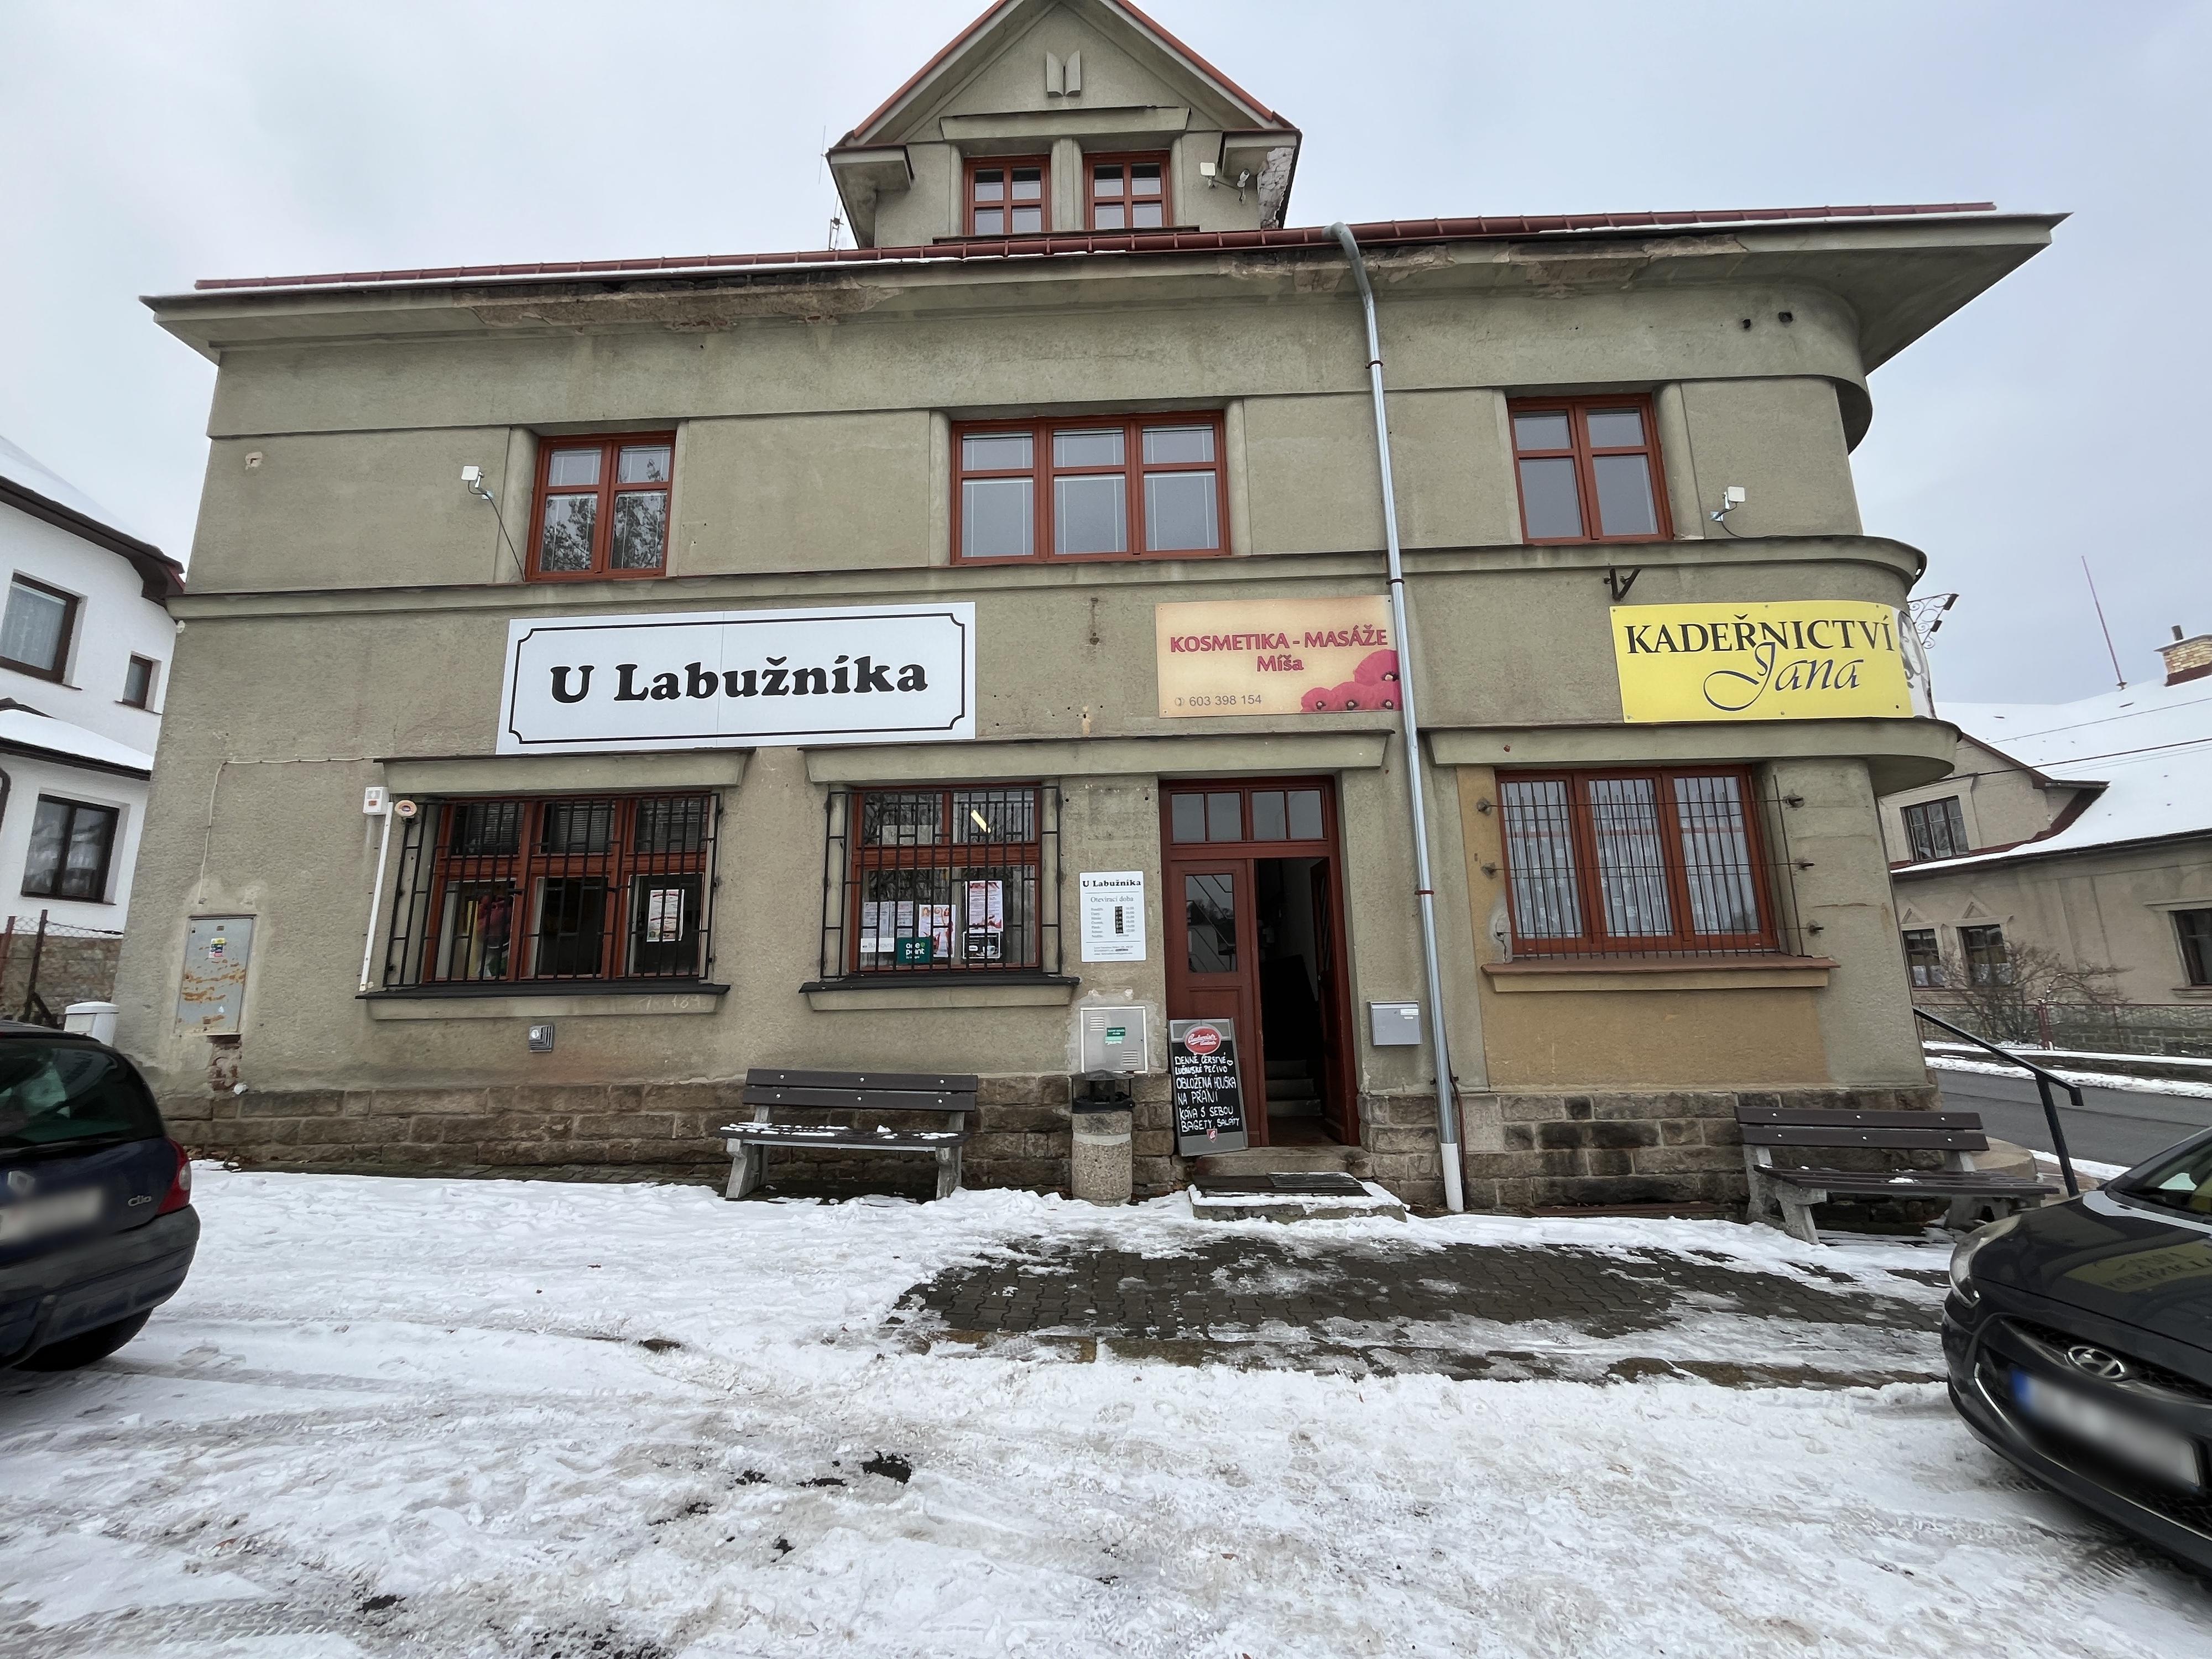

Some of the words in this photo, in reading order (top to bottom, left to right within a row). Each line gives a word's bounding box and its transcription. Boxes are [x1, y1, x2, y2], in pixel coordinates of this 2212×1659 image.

[1170, 632, 1290, 653] KOSMETIKA
[1304, 624, 1388, 648] MASÁŽE
[1624, 614, 1895, 654] KADEŘNICTVÍ
[1256, 654, 1305, 672] Míša
[551, 665, 595, 703] U
[614, 655, 928, 701] Labužníka
[1703, 641, 1864, 711] Jana
[1188, 696, 1211, 707] 603
[1214, 695, 1237, 706] 398
[1241, 694, 1262, 705] 154
[1175, 1053, 1199, 1065] DENNĚ
[1203, 1065, 1228, 1073] PEČIVO
[1176, 1074, 1212, 1089] OBLOŽENÁ
[1214, 1076, 1237, 1089] HOUSKA
[1177, 1092, 1188, 1105] NA
[1191, 1088, 1218, 1104] PŘÁNÍ
[1179, 1106, 1198, 1121] KÁVA
[1201, 1106, 1206, 1118] S
[1209, 1105, 1234, 1117] SEBOU
[1217, 1115, 1240, 1128] SALÁTY
[128, 1195, 152, 1207] Clio
